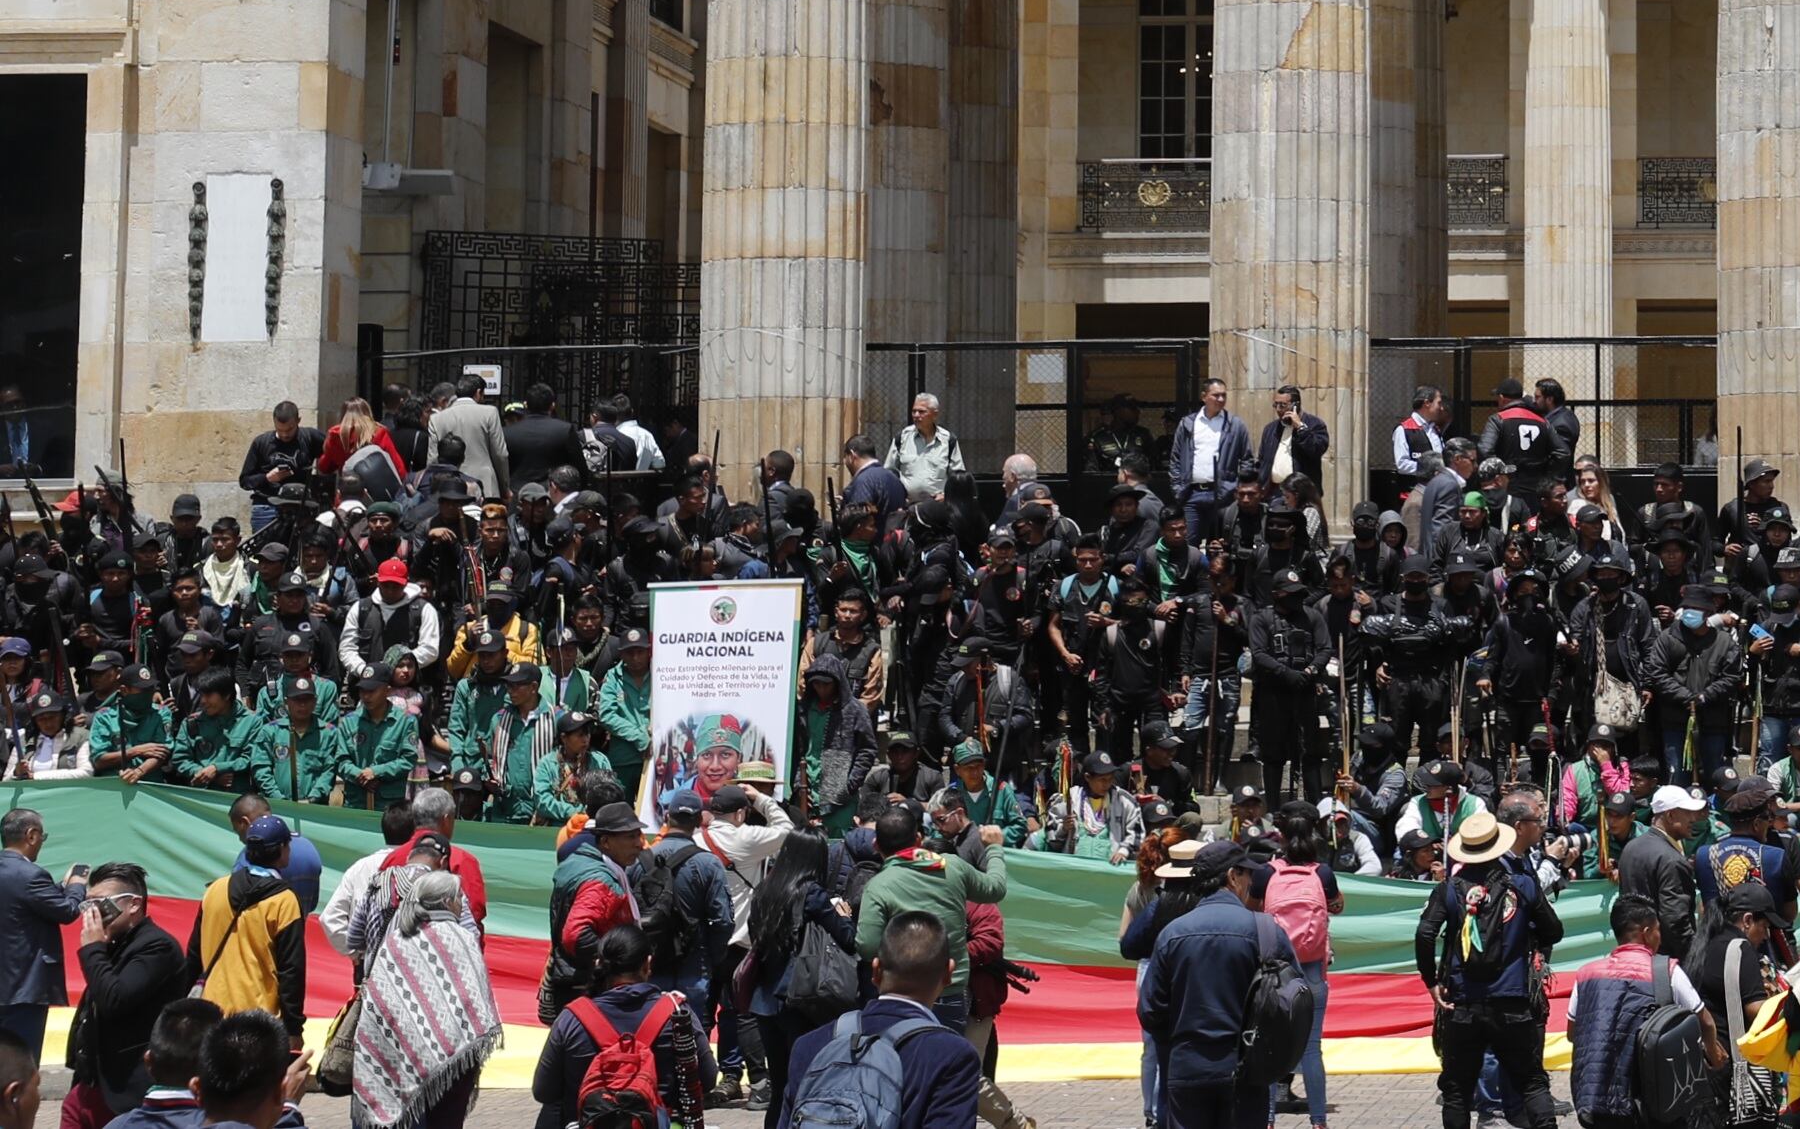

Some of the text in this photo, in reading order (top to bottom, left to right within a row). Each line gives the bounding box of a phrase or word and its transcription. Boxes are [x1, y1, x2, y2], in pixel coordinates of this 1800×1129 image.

[1559, 550, 1582, 573] ONCE
[659, 628, 785, 644] GUARDIA INDÍGENA
[686, 646, 755, 658] NACIONAL
[678, 664, 720, 674] Estratégico
[721, 664, 757, 672] Milenario
[757, 665, 775, 673] para
[776, 663, 784, 671] el
[660, 674, 690, 682] Cuidado
[697, 673, 728, 681] Defensa
[750, 673, 770, 681] Vida,
[678, 682, 685, 690] la
[717, 681, 724, 689] el
[725, 680, 760, 689] Territorio
[768, 681, 776, 689] la
[691, 690, 717, 699] Madre
